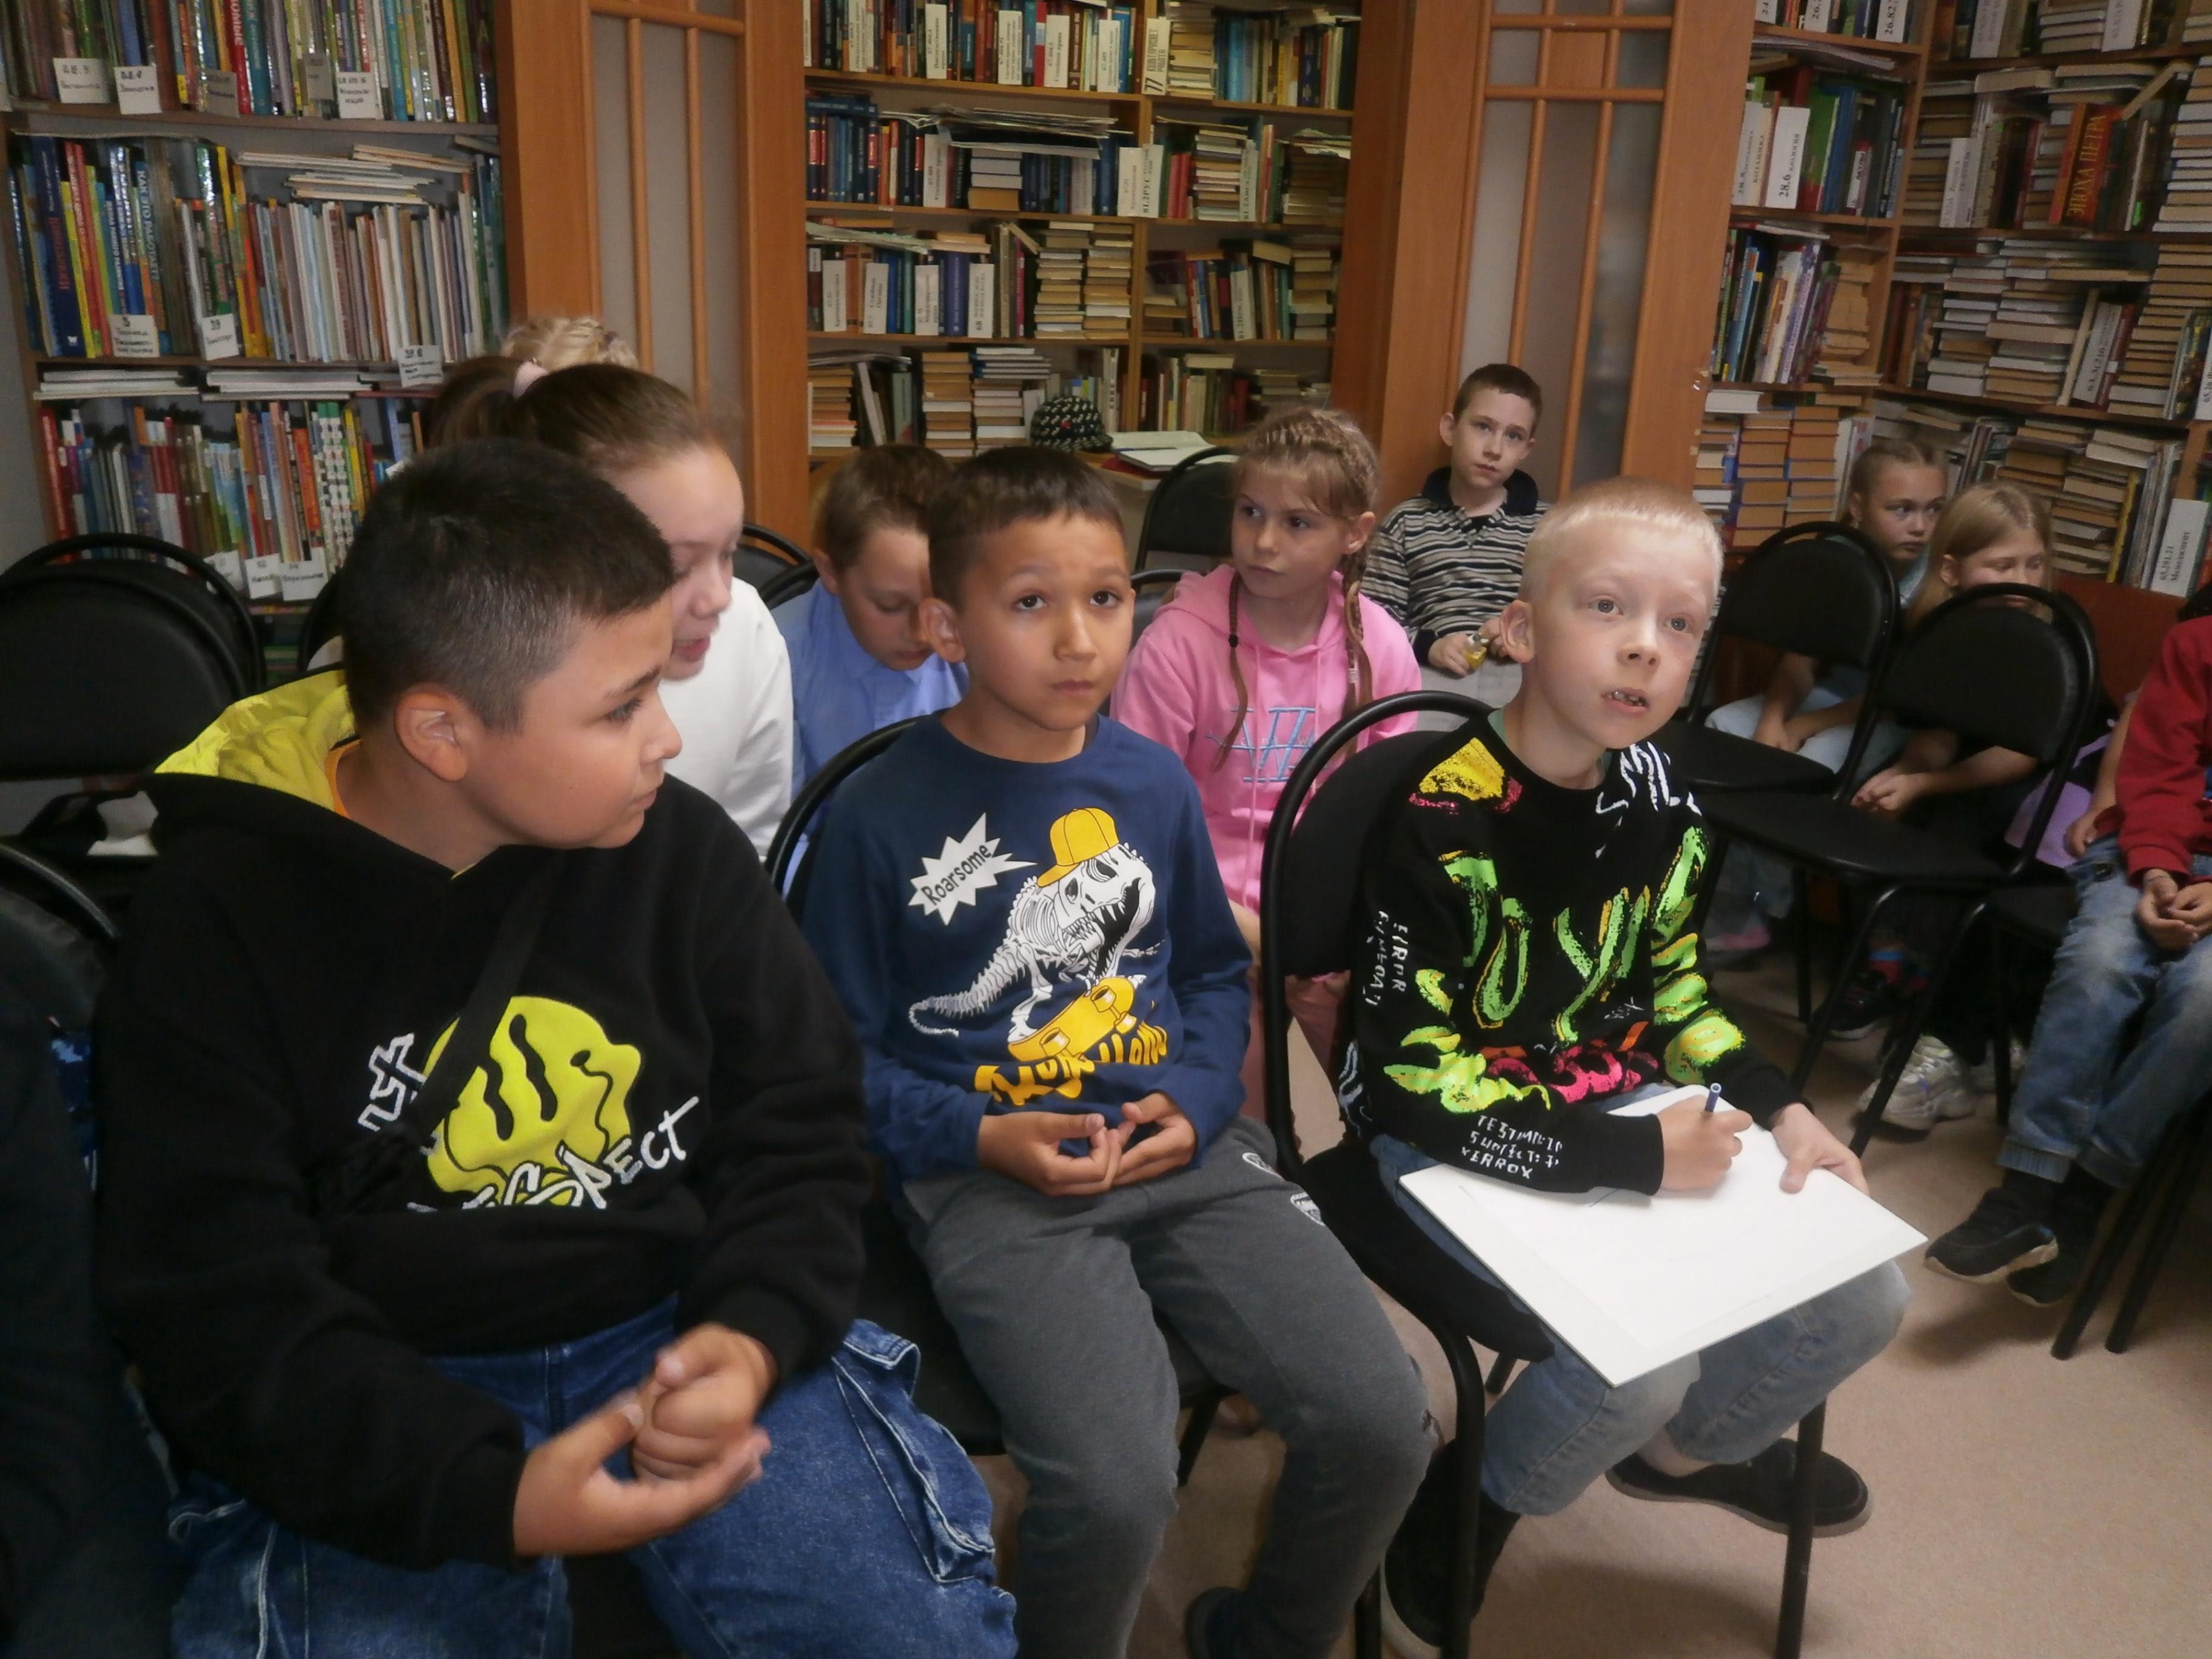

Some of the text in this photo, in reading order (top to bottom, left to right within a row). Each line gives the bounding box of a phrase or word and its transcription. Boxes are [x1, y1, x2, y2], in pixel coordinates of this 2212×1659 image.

[1144, 77, 1164, 92] 77
[1778, 173, 1791, 199] 28.6
[2066, 114, 2106, 216] ЭПОХА ПЕТРА
[920, 842, 993, 907] Roarsome
